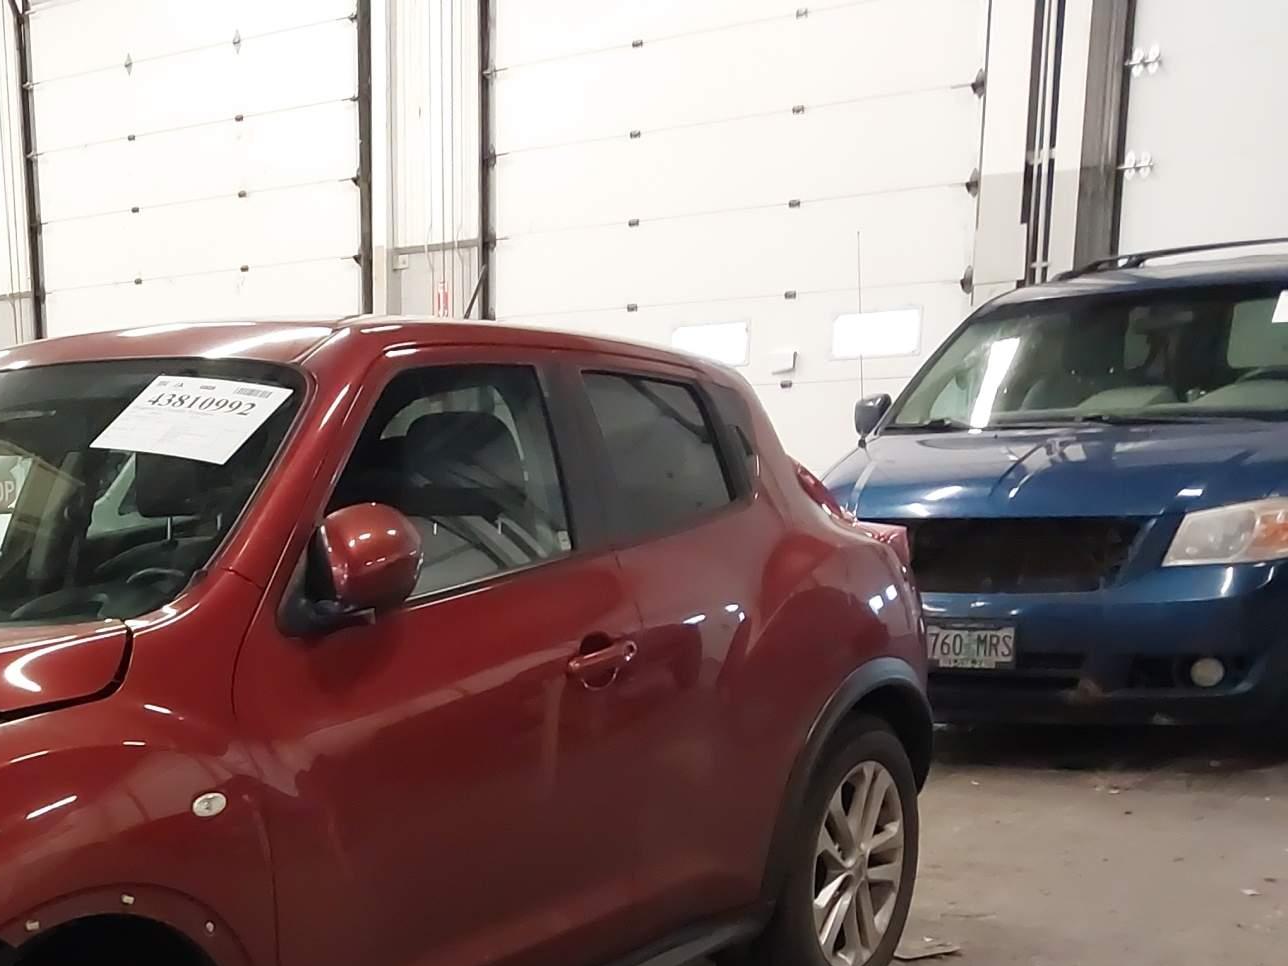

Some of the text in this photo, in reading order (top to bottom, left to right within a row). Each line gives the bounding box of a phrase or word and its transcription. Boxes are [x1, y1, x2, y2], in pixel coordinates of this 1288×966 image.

[147, 391, 257, 416] 43810992
[928, 632, 1012, 657] 760 MRS
